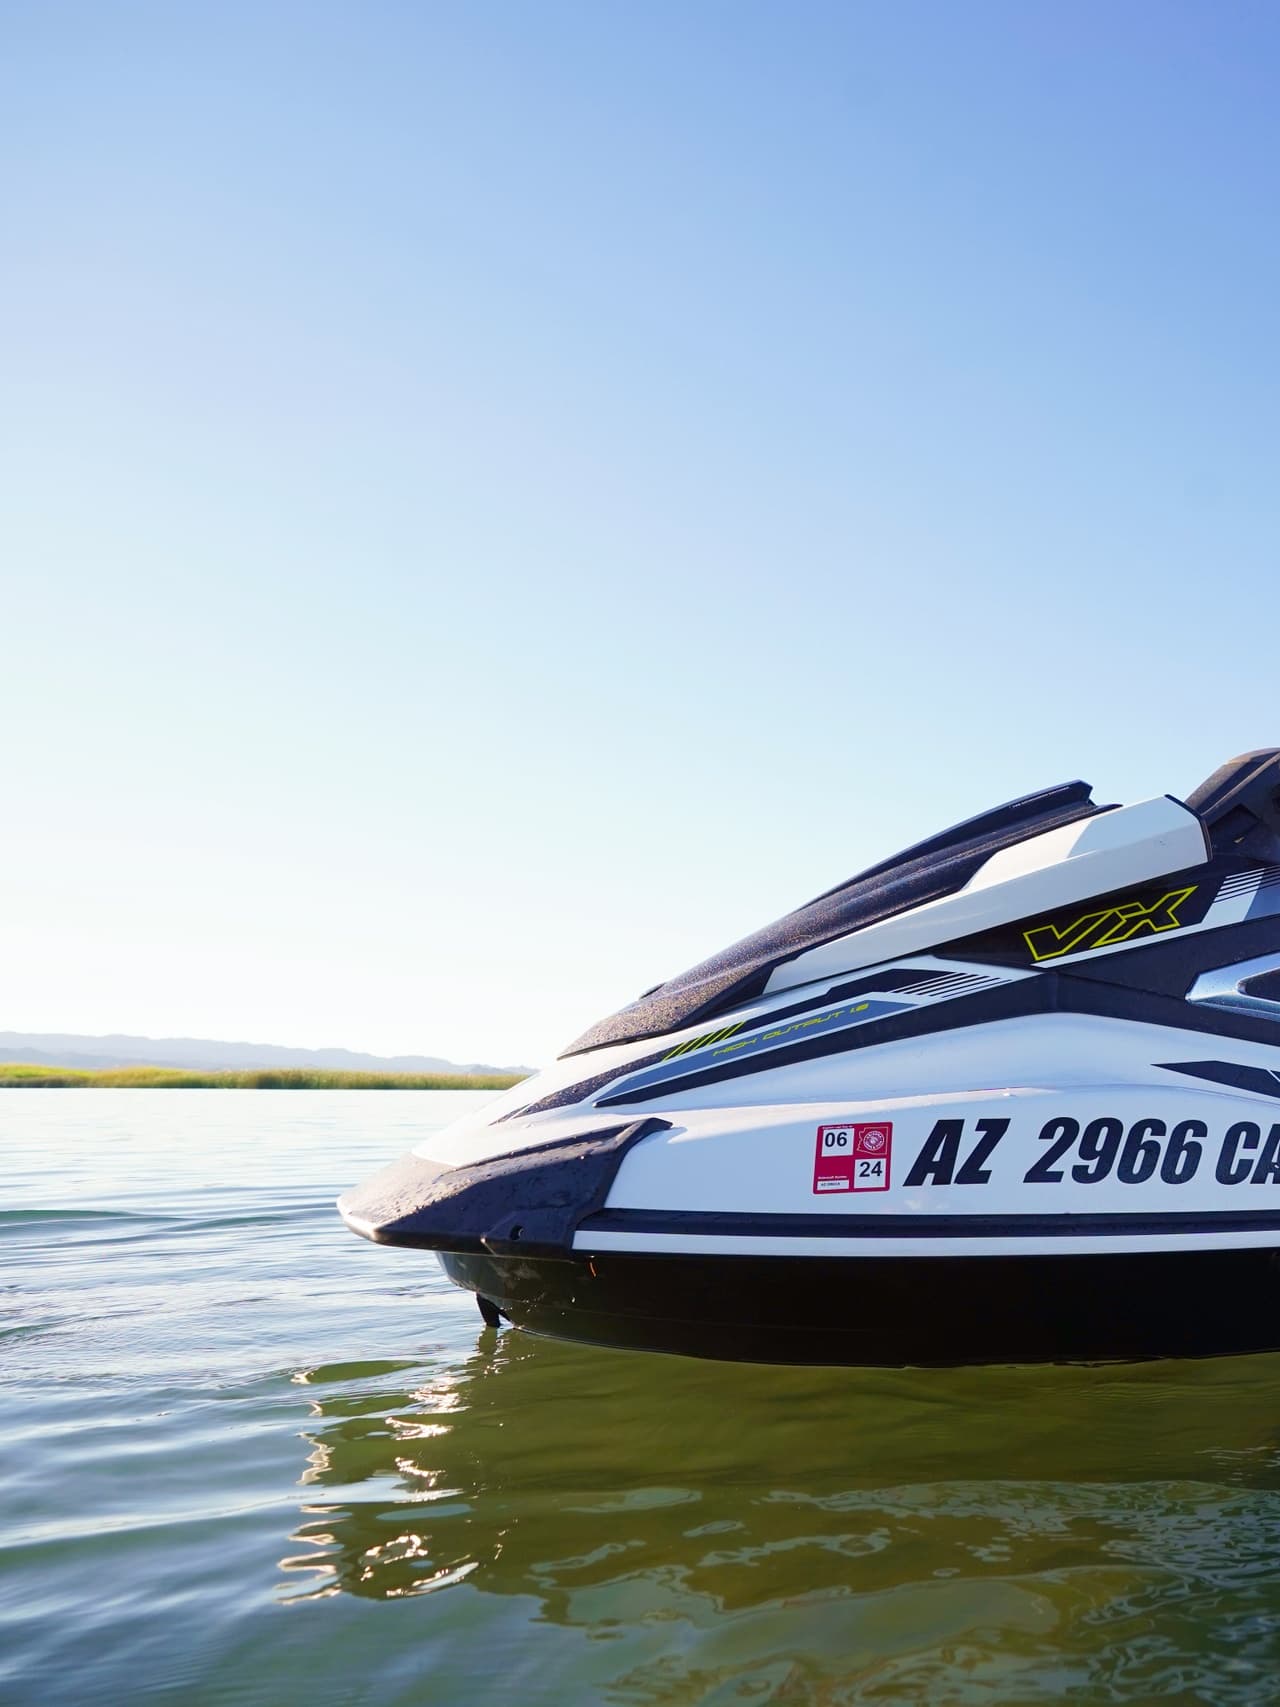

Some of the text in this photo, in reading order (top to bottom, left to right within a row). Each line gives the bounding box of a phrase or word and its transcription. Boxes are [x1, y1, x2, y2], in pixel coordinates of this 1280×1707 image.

[1022, 885, 1199, 961] VX
[762, 1010, 845, 1041] OUTPUT
[825, 1132, 848, 1147] 06
[902, 1118, 1011, 1187] AZ
[1023, 1116, 1208, 1185] 2966
[859, 1161, 883, 1177] 24
